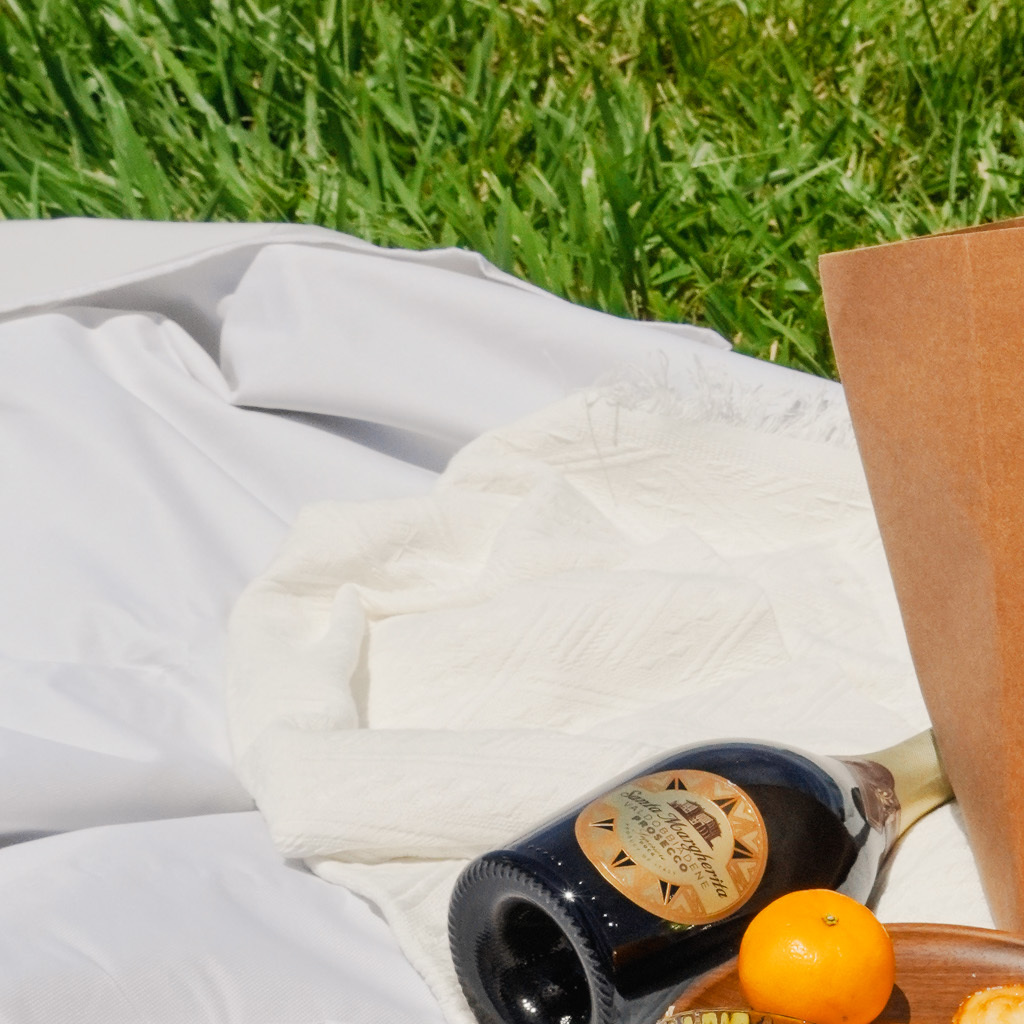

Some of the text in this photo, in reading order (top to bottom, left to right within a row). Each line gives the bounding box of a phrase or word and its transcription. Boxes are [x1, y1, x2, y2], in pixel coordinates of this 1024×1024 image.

[620, 790, 662, 814] Santa
[657, 812, 728, 898] Margherita
[632, 815, 689, 873] PROSECCO
